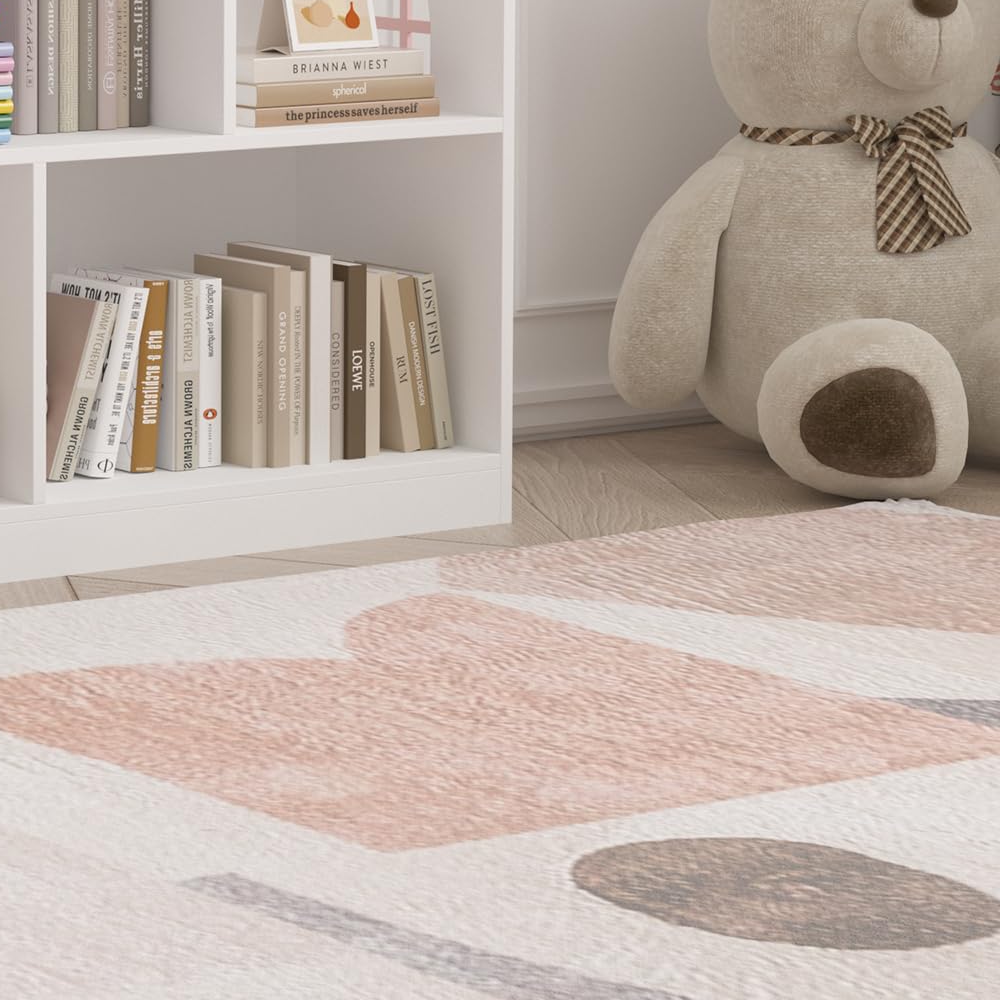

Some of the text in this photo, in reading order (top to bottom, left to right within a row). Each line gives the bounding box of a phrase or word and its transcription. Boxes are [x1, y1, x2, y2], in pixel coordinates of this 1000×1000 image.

[292, 58, 389, 74] BRIANNA WIEST
[286, 102, 419, 123] the princess saves herself
[421, 279, 441, 356] LOST FISH
[256, 360, 264, 393] NORDIC
[278, 311, 287, 412] GRAND OPENING
[331, 332, 341, 411] CONSIDERED
[351, 349, 363, 392] LOEWE
[368, 341, 376, 388] OPENHOUSE
[395, 355, 408, 384] RUM
[408, 321, 426, 406] DANISH MODERN DESIGN
[293, 375, 301, 398] POWER
